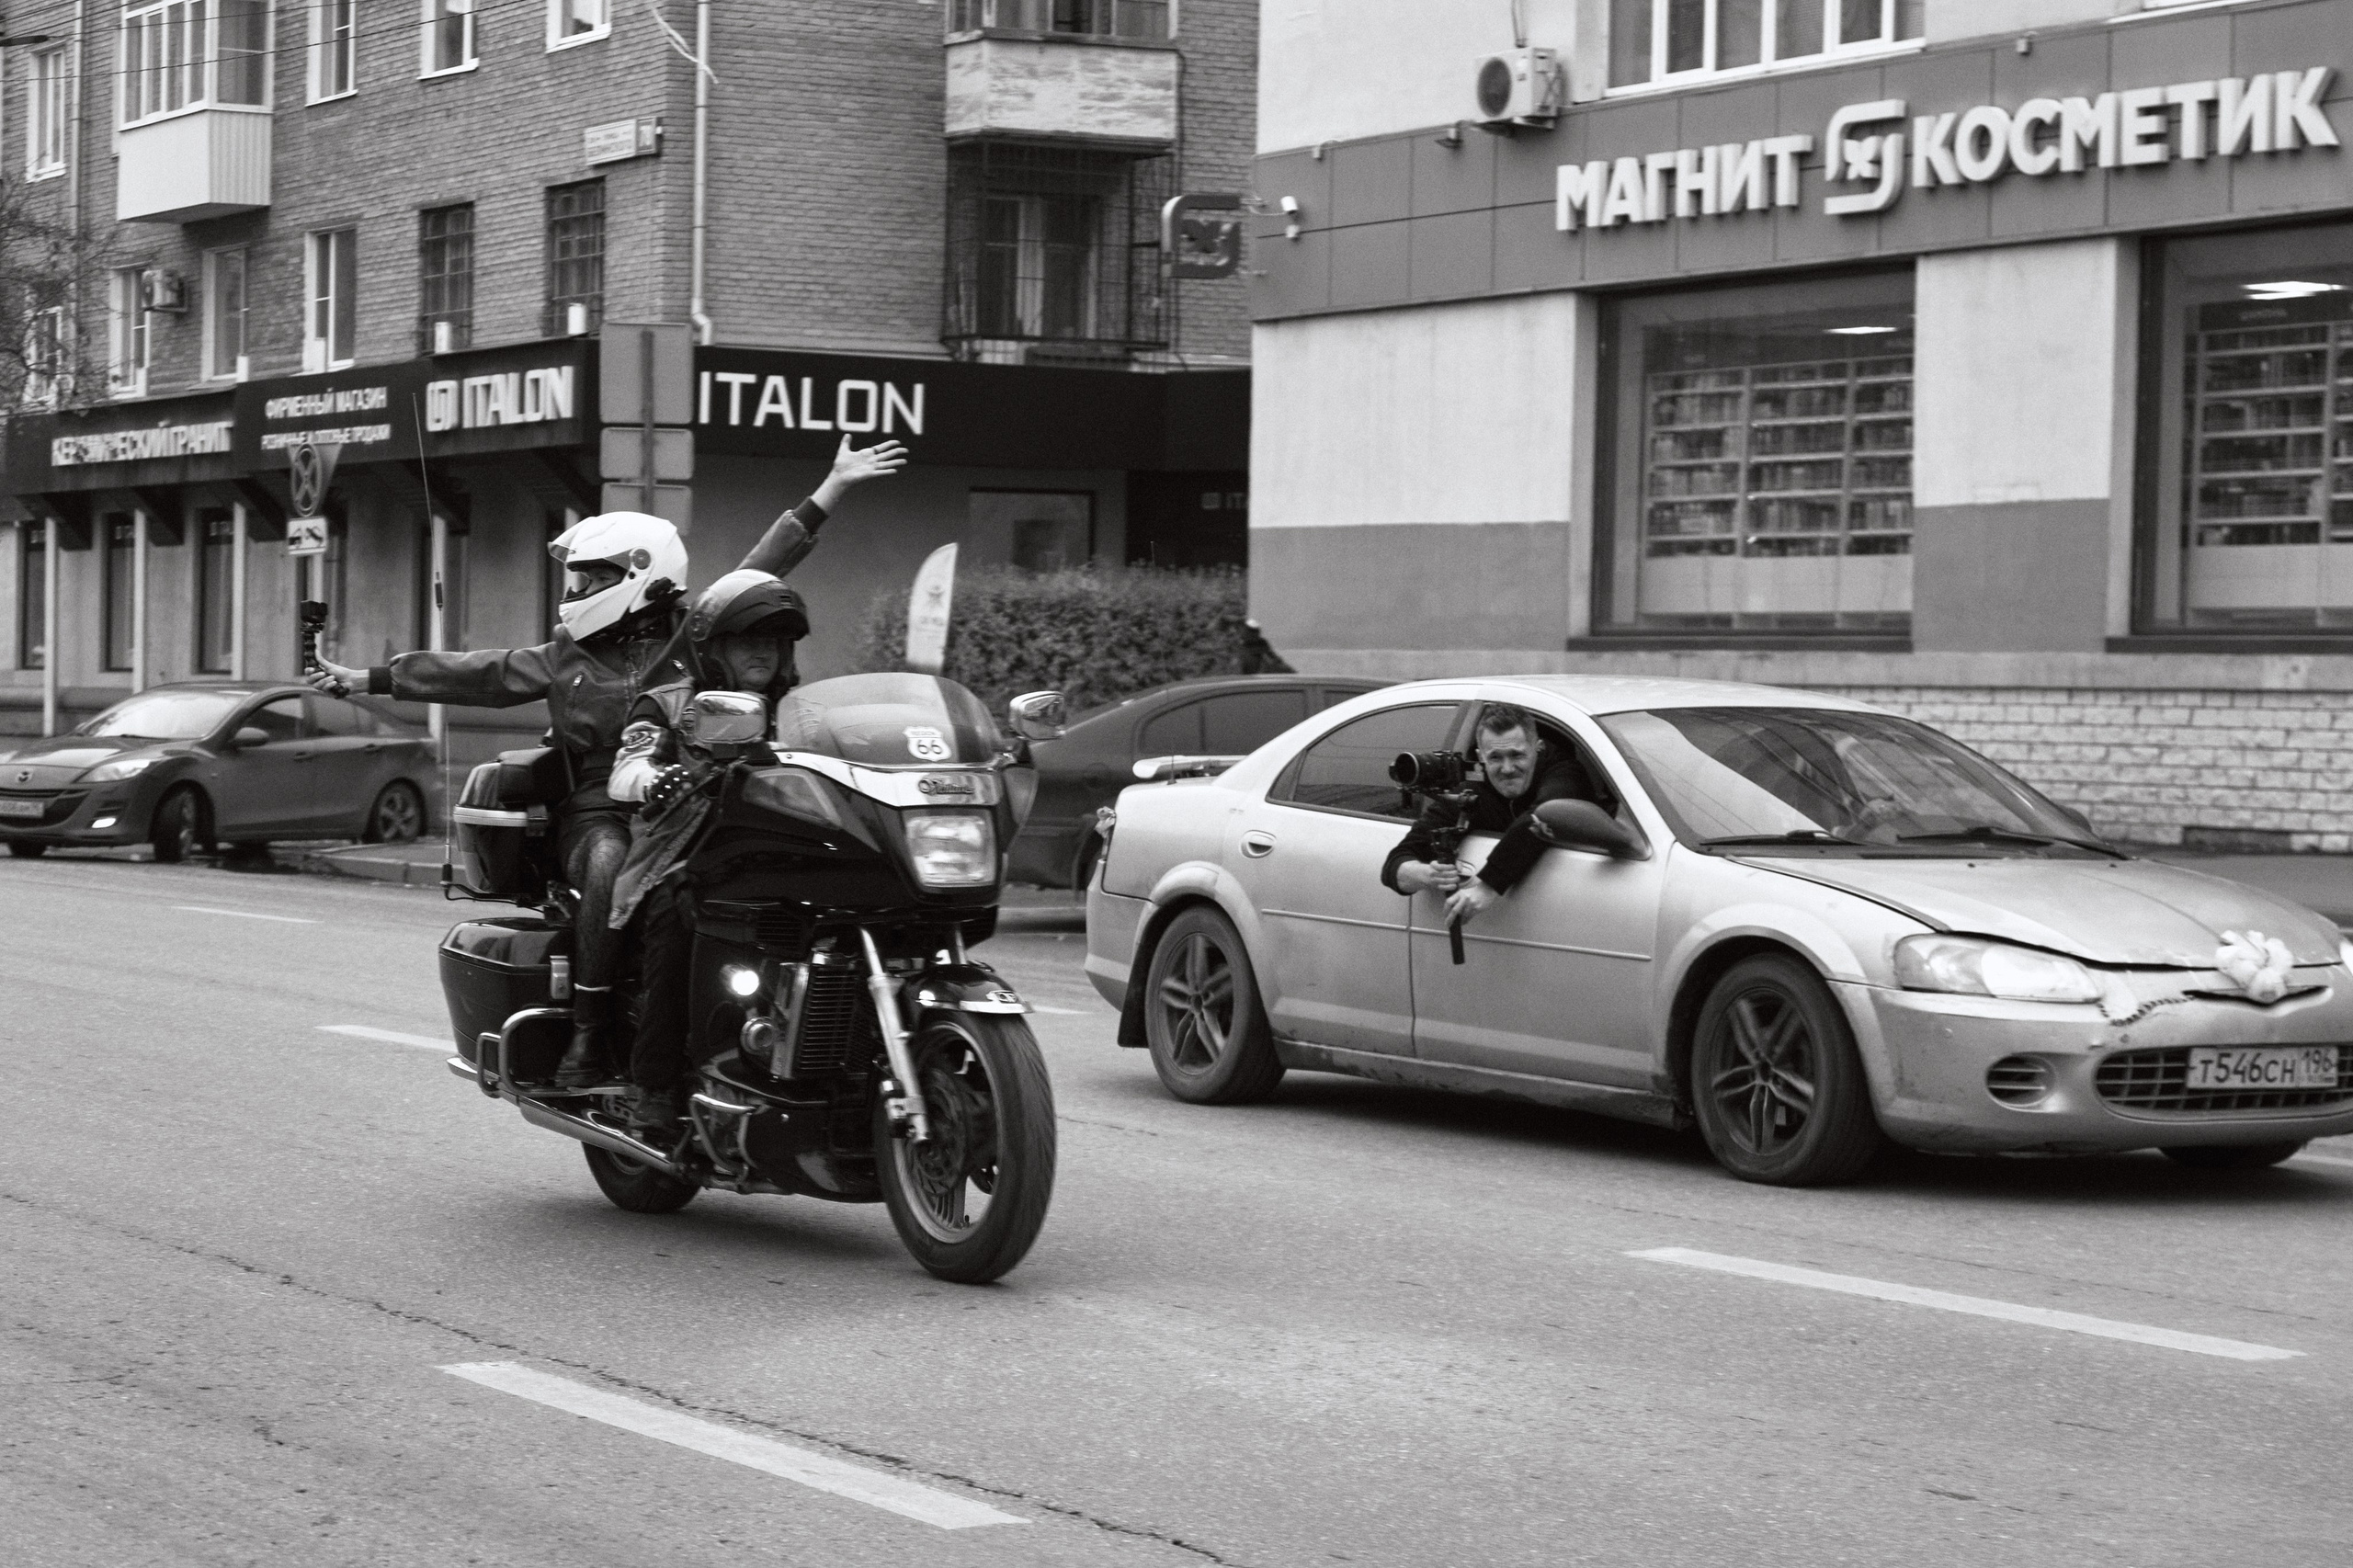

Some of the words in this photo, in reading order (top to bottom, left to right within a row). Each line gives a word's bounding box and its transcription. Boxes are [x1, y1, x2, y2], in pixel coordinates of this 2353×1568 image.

[1556, 134, 1813, 231] МАГНИТ
[1912, 67, 2340, 187] КОСМЕТИК
[265, 387, 335, 420] ФИРМЕННЫЙ
[336, 387, 387, 413] МАГАЗИН
[463, 366, 574, 428] ITALON
[699, 371, 924, 435] ITALON
[171, 421, 233, 457] ГРАНИТ
[917, 739, 943, 755] 66
[2200, 1052, 2296, 1084] Т546СН
